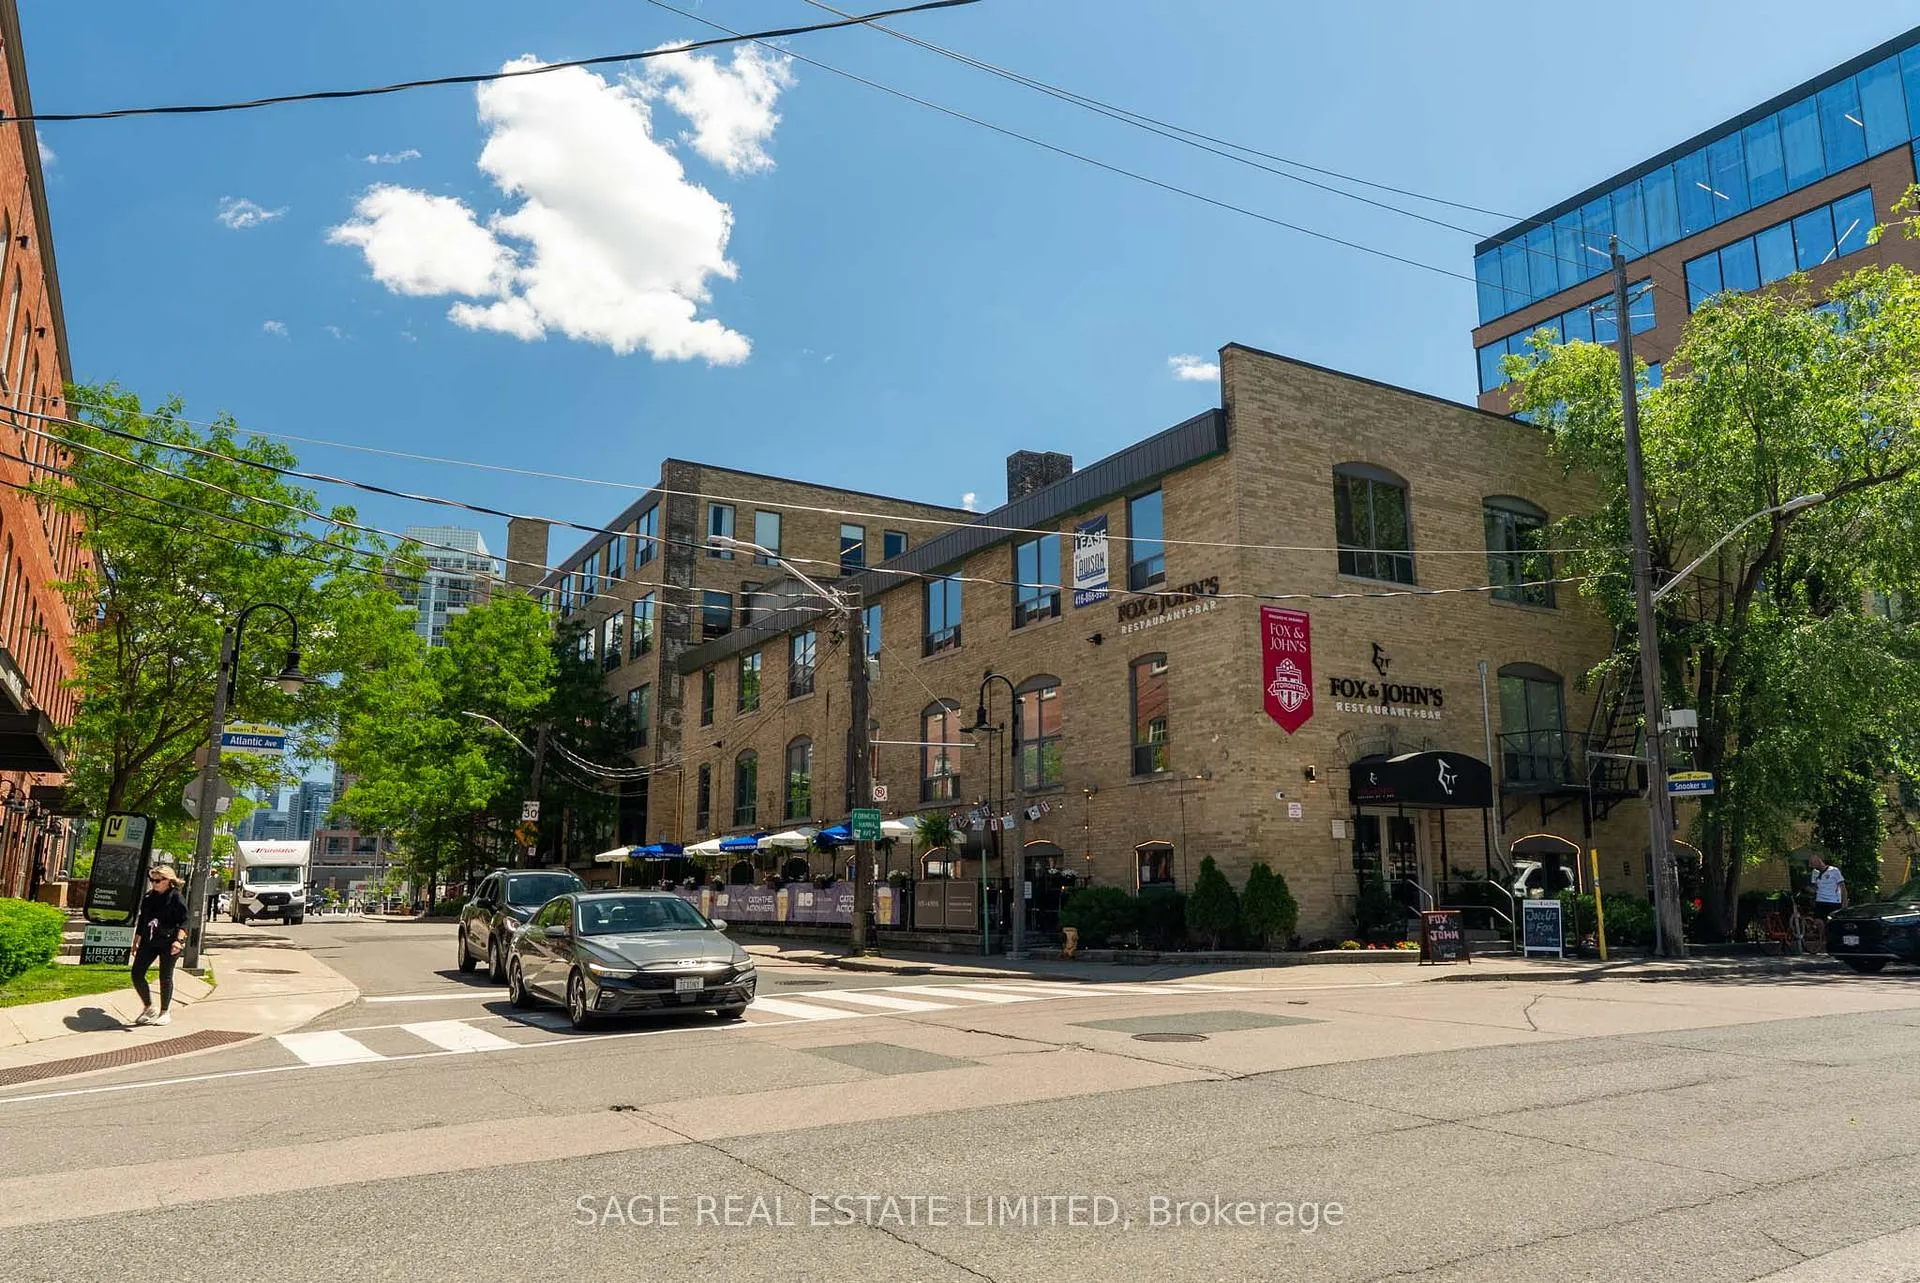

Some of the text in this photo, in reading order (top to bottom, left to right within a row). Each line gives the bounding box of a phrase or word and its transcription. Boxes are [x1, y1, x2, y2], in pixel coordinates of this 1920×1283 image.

[1117, 598, 1147, 623] FOX
[1269, 622, 1305, 639] FOX &
[1269, 637, 1307, 653] JOHN'S
[1275, 681, 1305, 692] TORONTO
[1328, 677, 1368, 700] FOX
[1381, 682, 1444, 707] JOHN'S
[229, 735, 263, 747] Atlantic
[1674, 782, 1700, 790] Snooker
[524, 809, 538, 818] 30
[86, 947, 127, 956] LIBERTY
[84, 955, 115, 963] KICKS
